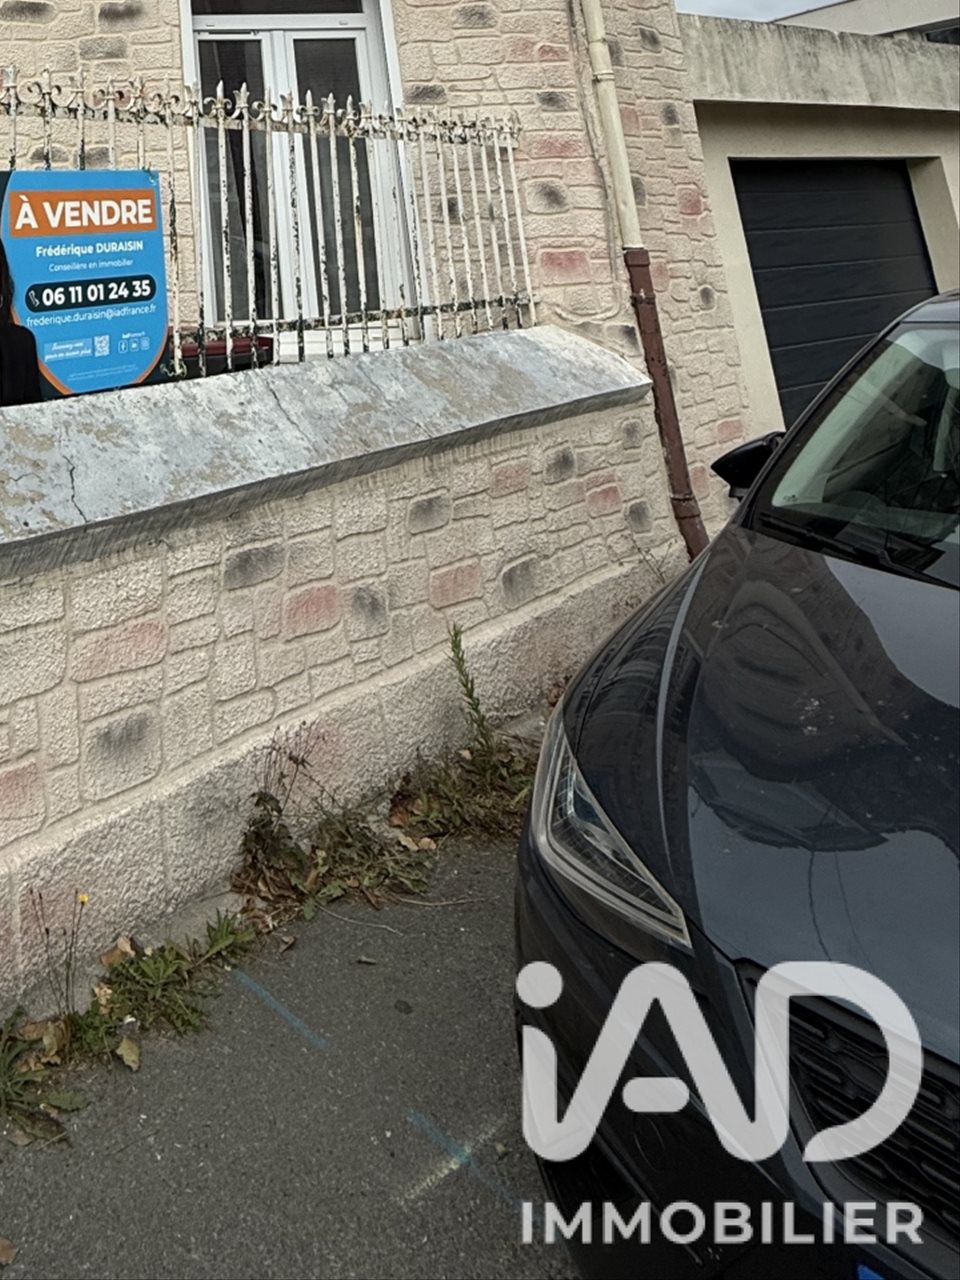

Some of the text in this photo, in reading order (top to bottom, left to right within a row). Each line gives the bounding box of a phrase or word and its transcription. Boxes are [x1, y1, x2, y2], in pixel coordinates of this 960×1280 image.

[14, 194, 153, 230] À VENDRE
[35, 240, 144, 258] Frédérique DURAISIN
[48, 258, 134, 272] Conseillère en immobilier
[42, 279, 151, 307] 06 11 01 24 35
